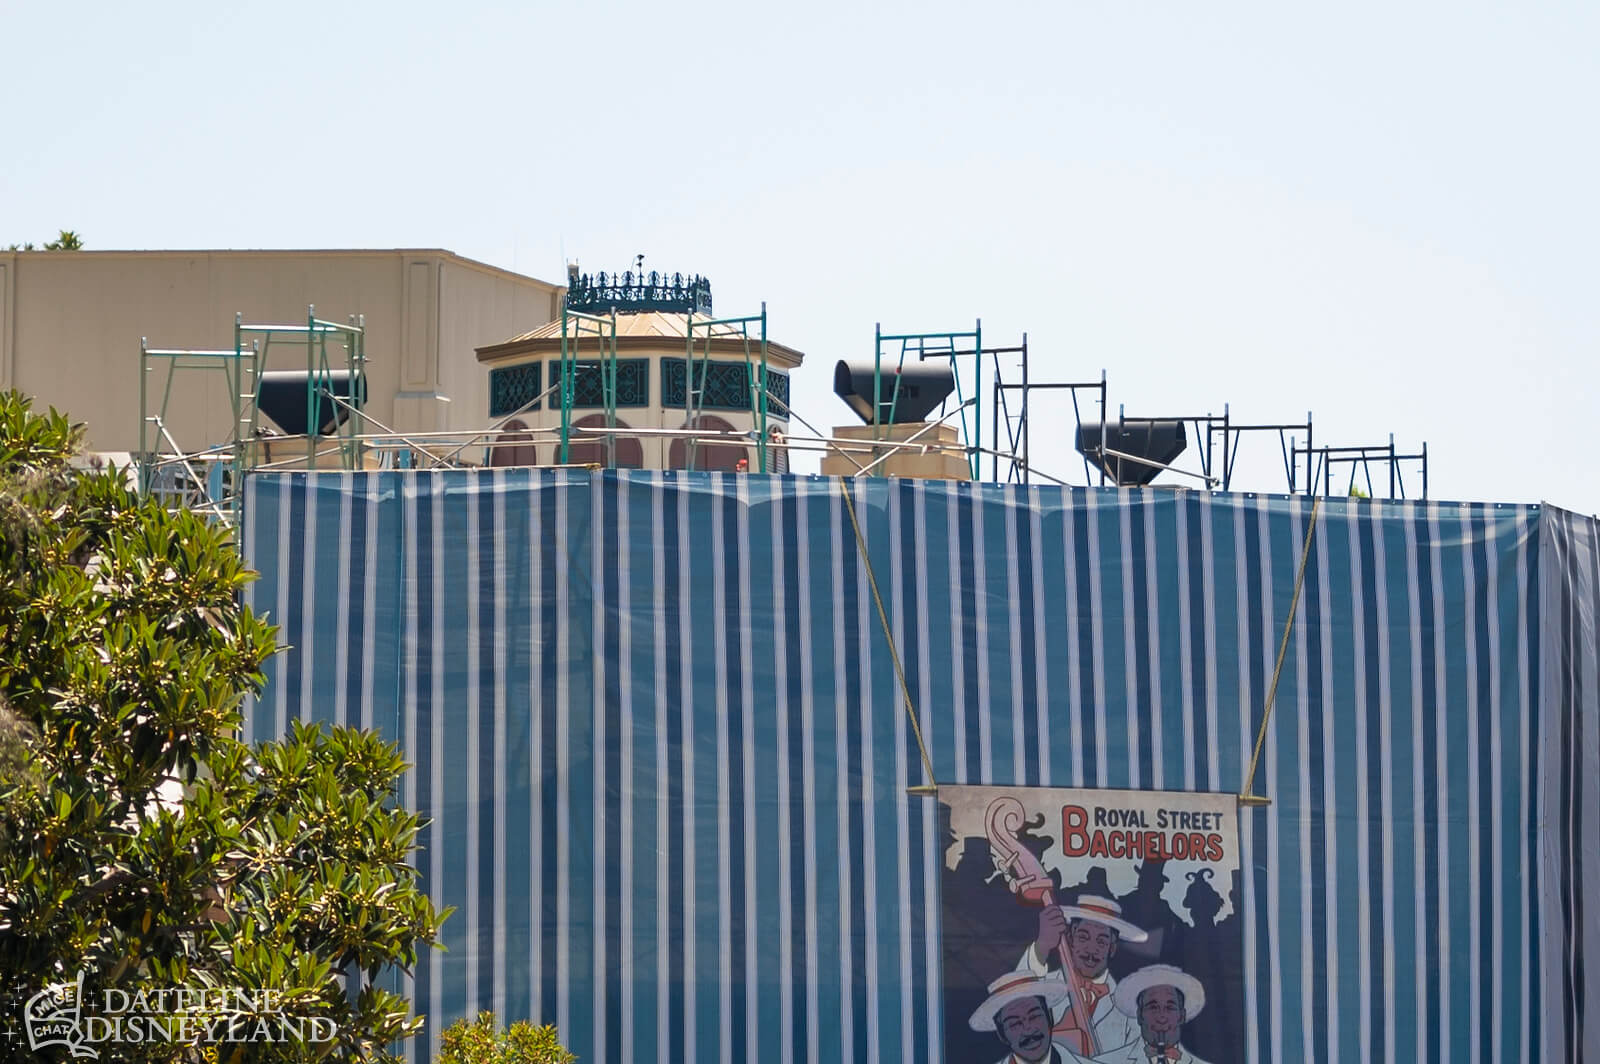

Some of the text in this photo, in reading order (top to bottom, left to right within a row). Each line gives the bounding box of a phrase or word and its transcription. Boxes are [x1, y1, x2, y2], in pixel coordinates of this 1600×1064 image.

[1061, 805, 1223, 862] BACHELORS
[1094, 807, 1224, 830] ROYAL STREET
